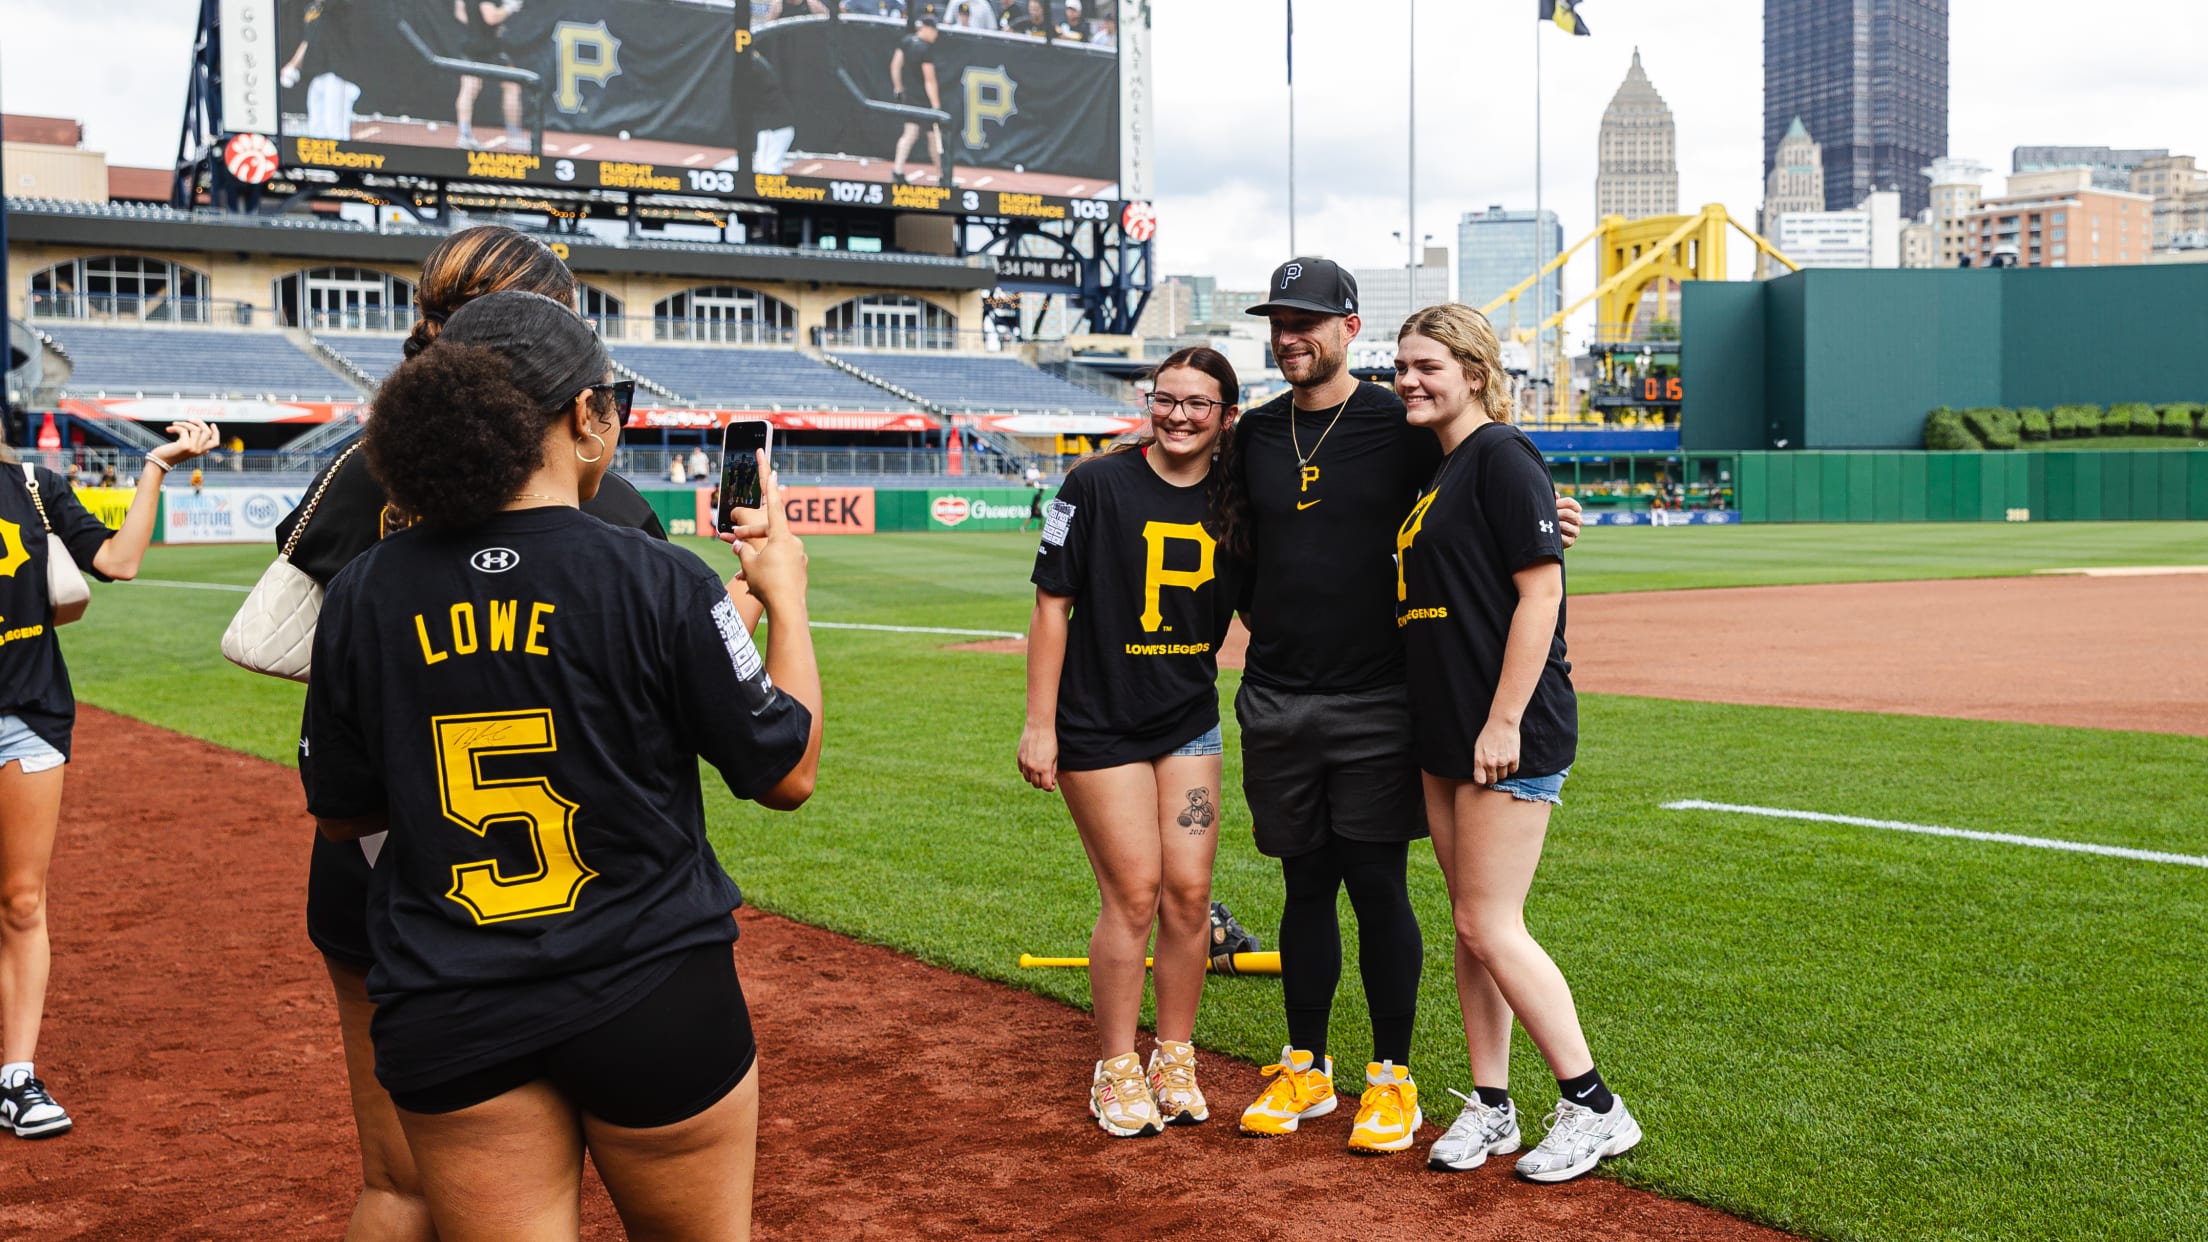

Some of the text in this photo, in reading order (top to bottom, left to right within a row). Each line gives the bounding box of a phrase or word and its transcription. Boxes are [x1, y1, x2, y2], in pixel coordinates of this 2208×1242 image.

[735, 29, 751, 53] P
[552, 20, 623, 115] P
[960, 64, 1018, 150] P
[297, 137, 339, 152] EXIT
[297, 150, 385, 170] VELOCITY
[467, 151, 540, 169] LAUNCH
[600, 161, 653, 178] FLIGHT
[467, 165, 527, 180] ANGLE
[555, 159, 575, 182] 3
[755, 173, 788, 187] EXIT
[600, 174, 681, 191] DISTANCE
[687, 169, 735, 193] 103
[755, 184, 825, 202] VELOCITY
[830, 181, 883, 204] 107.5
[892, 184, 950, 200] LAUNCH
[962, 190, 980, 211] 3
[999, 192, 1043, 206] FLIGHT
[892, 197, 940, 210] ANGLE
[999, 203, 1065, 218] DISTANCE
[1070, 199, 1109, 220] 103
[1022, 261, 1045, 277] PM
[1281, 263, 1303, 289] P
[1301, 465, 1320, 492] P
[1140, 520, 1217, 632] P
[414, 599, 556, 665] LOWE
[1167, 642, 1210, 655] LEGEDS
[432, 708, 600, 925] 5
